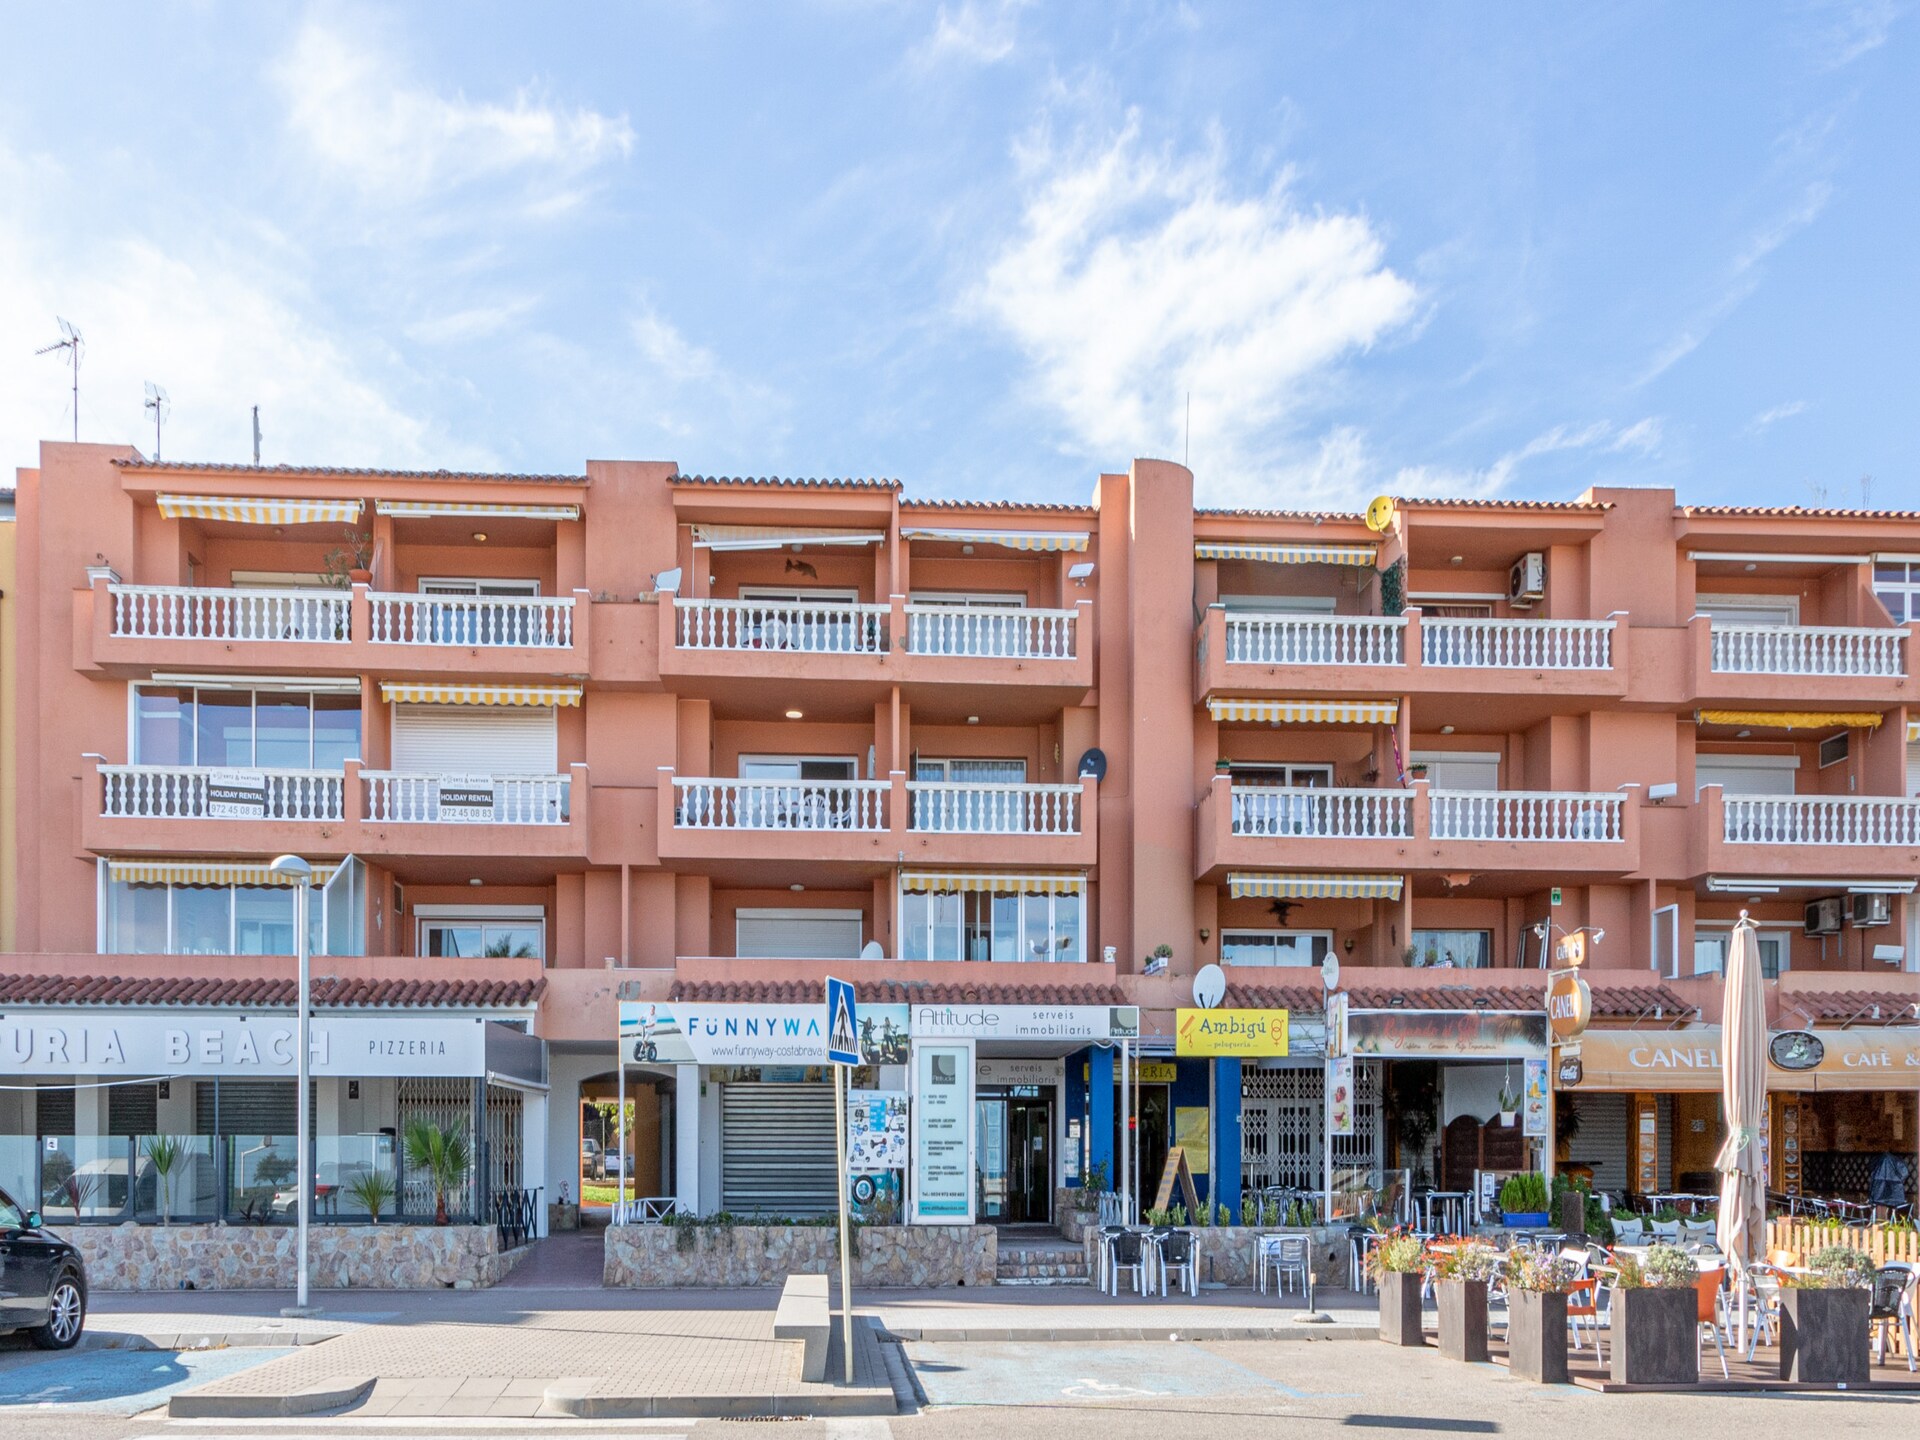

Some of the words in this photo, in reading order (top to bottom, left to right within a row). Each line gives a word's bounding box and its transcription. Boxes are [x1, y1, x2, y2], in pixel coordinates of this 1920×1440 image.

[210, 789, 238, 799] HOLIDAY
[238, 791, 264, 801] RENTAL
[440, 793, 468, 801] HOLIDAY
[468, 793, 493, 802] RENTAL
[211, 804, 226, 814] 972
[228, 805, 239, 815] 45
[240, 806, 251, 815] 08
[252, 806, 262, 816] 83
[441, 808, 457, 817] 972
[458, 808, 469, 818] 45
[470, 808, 480, 818] 08
[482, 808, 492, 818] 83
[919, 1007, 1000, 1026] Attitude
[1032, 1009, 1074, 1020] serveis
[688, 1017, 820, 1037] FÜNNYWA
[1015, 1024, 1092, 1035] immobiliaris
[1200, 1016, 1267, 1039] Ambigú
[0, 1028, 125, 1064] URIA
[165, 1029, 330, 1065] BEACH
[369, 1040, 446, 1055] PIZZERIA
[711, 1044, 828, 1059] www.funnyway-costabrava.c
[1629, 1047, 1722, 1068] CANEL
[1010, 1064, 1042, 1072] serveis
[996, 1074, 1056, 1084] immobiliaris
